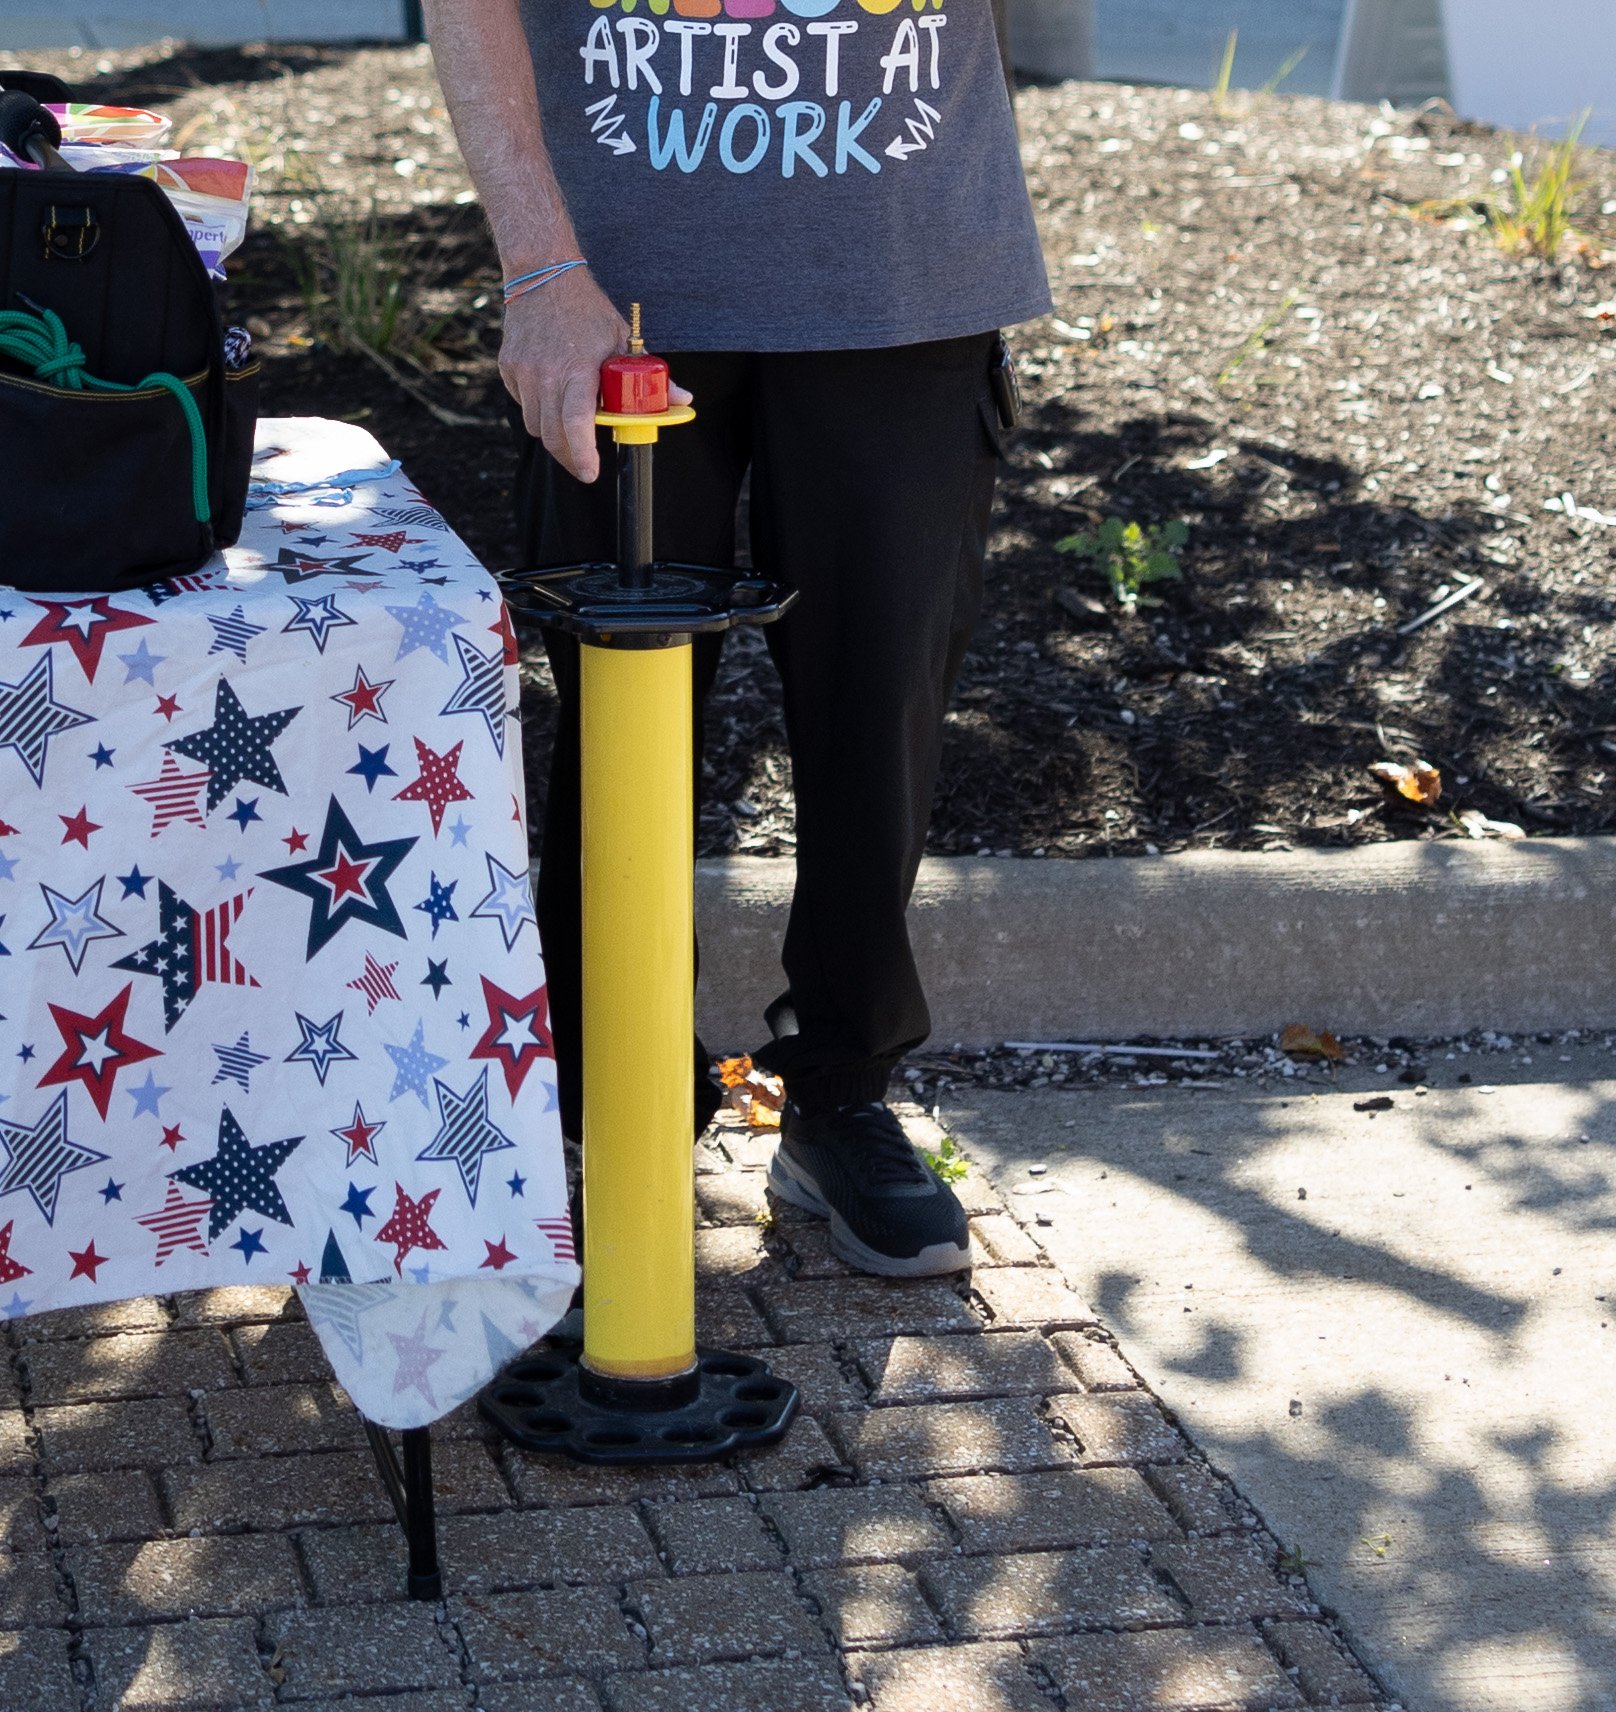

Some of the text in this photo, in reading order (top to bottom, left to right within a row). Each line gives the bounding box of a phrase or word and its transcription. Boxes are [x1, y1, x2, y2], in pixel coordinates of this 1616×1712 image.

[579, 14, 947, 100] ARTIST AT
[647, 95, 882, 178] WORK
